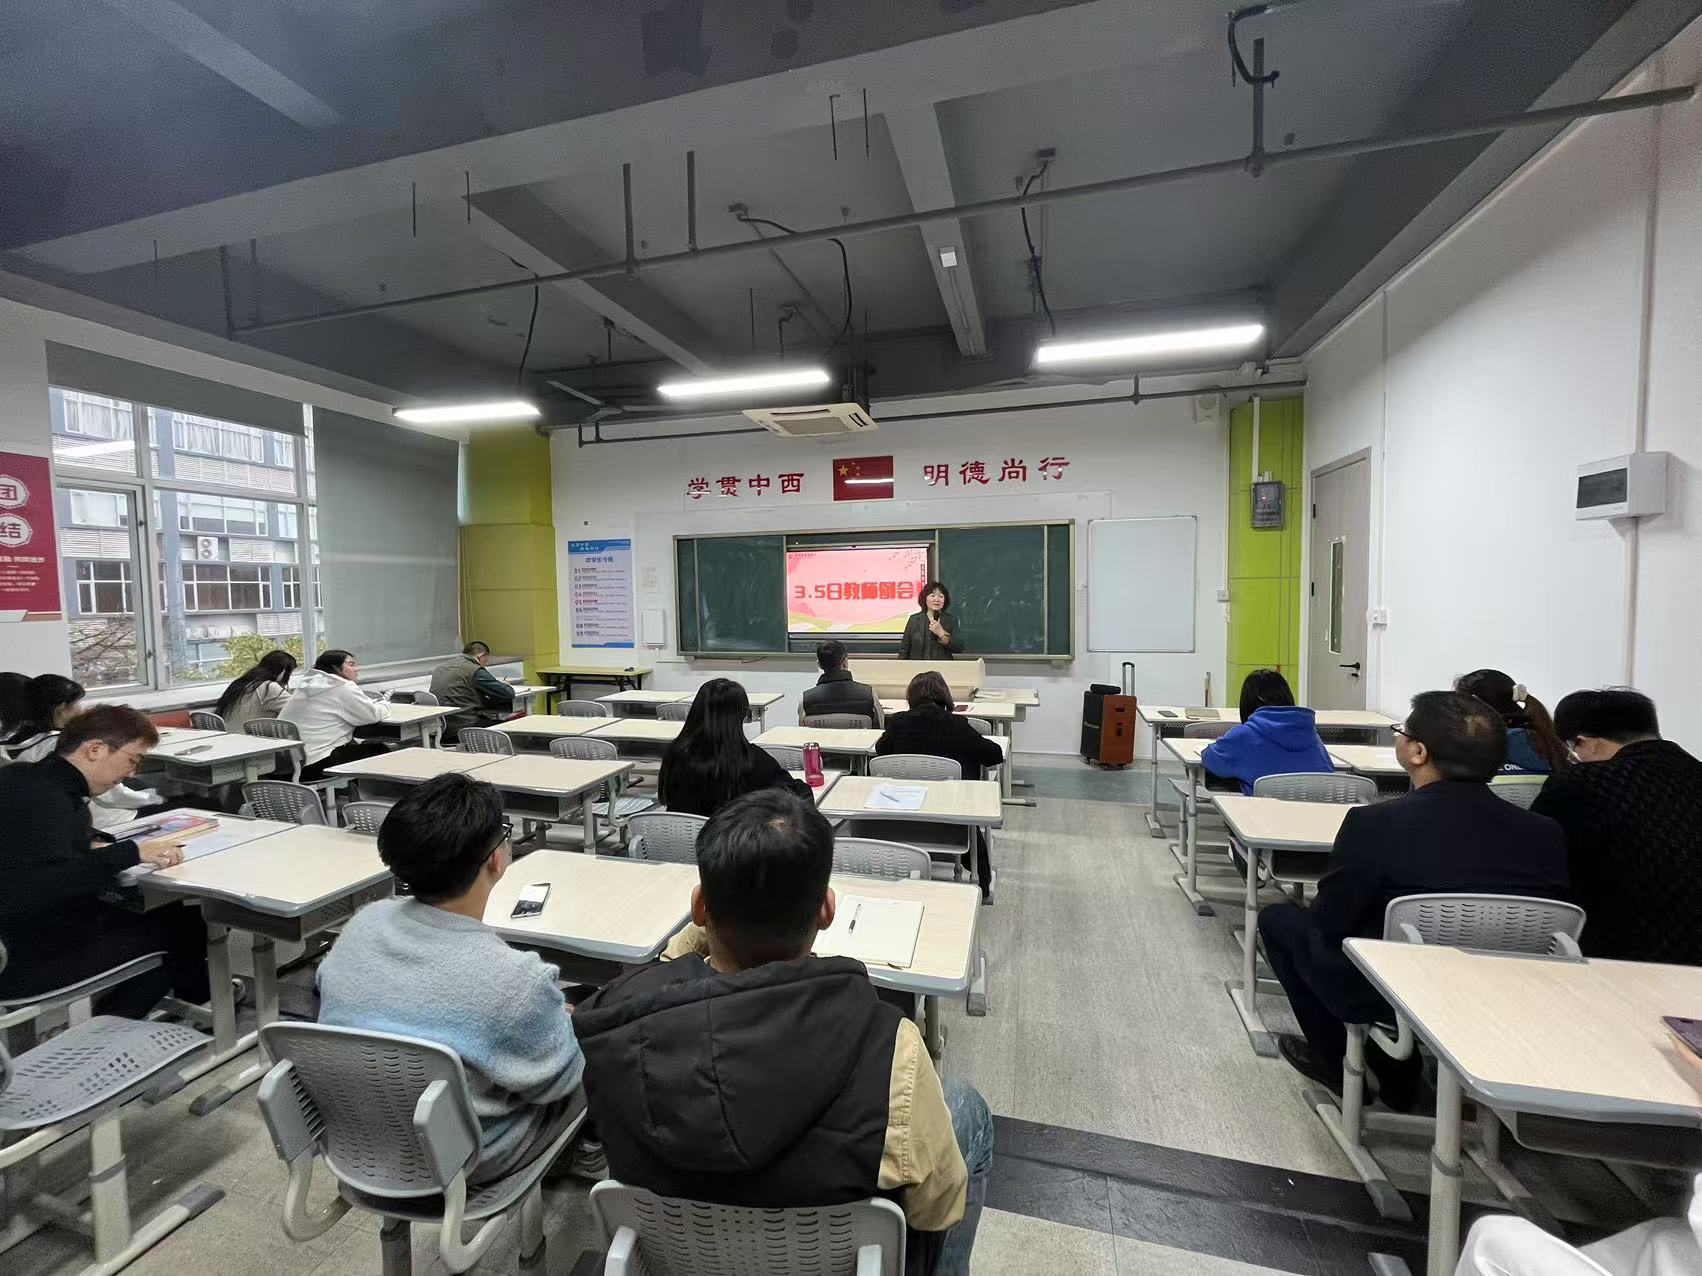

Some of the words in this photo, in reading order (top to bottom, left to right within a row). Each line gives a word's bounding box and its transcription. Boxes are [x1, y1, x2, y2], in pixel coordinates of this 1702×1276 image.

[687, 472, 805, 500] 学贯中西
[923, 456, 1070, 487] 明德尚行
